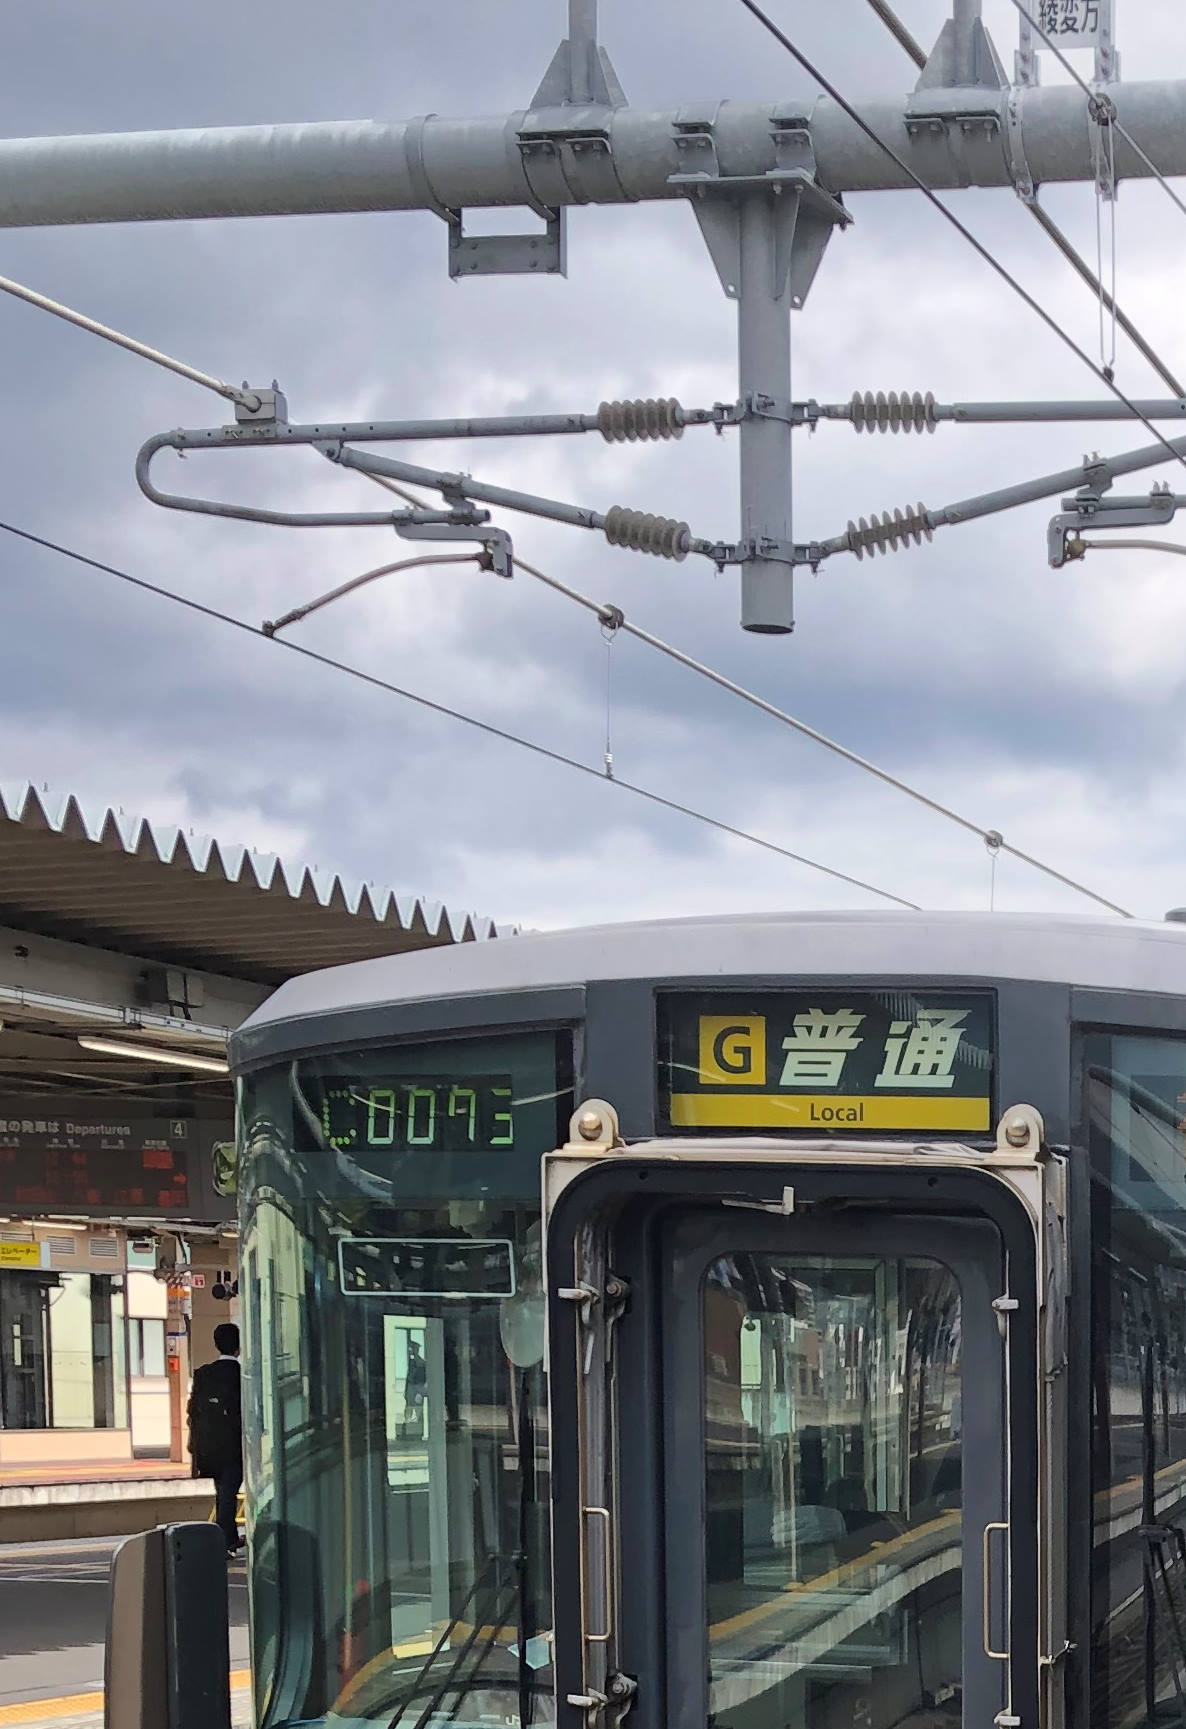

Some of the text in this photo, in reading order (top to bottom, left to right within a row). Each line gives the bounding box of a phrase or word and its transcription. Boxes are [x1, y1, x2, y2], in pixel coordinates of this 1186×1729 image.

[713, 1007, 972, 1088] G 普通
[810, 1102, 864, 1122] Local
[66, 1121, 131, 1136] Departures
[174, 1122, 183, 1136] 4
